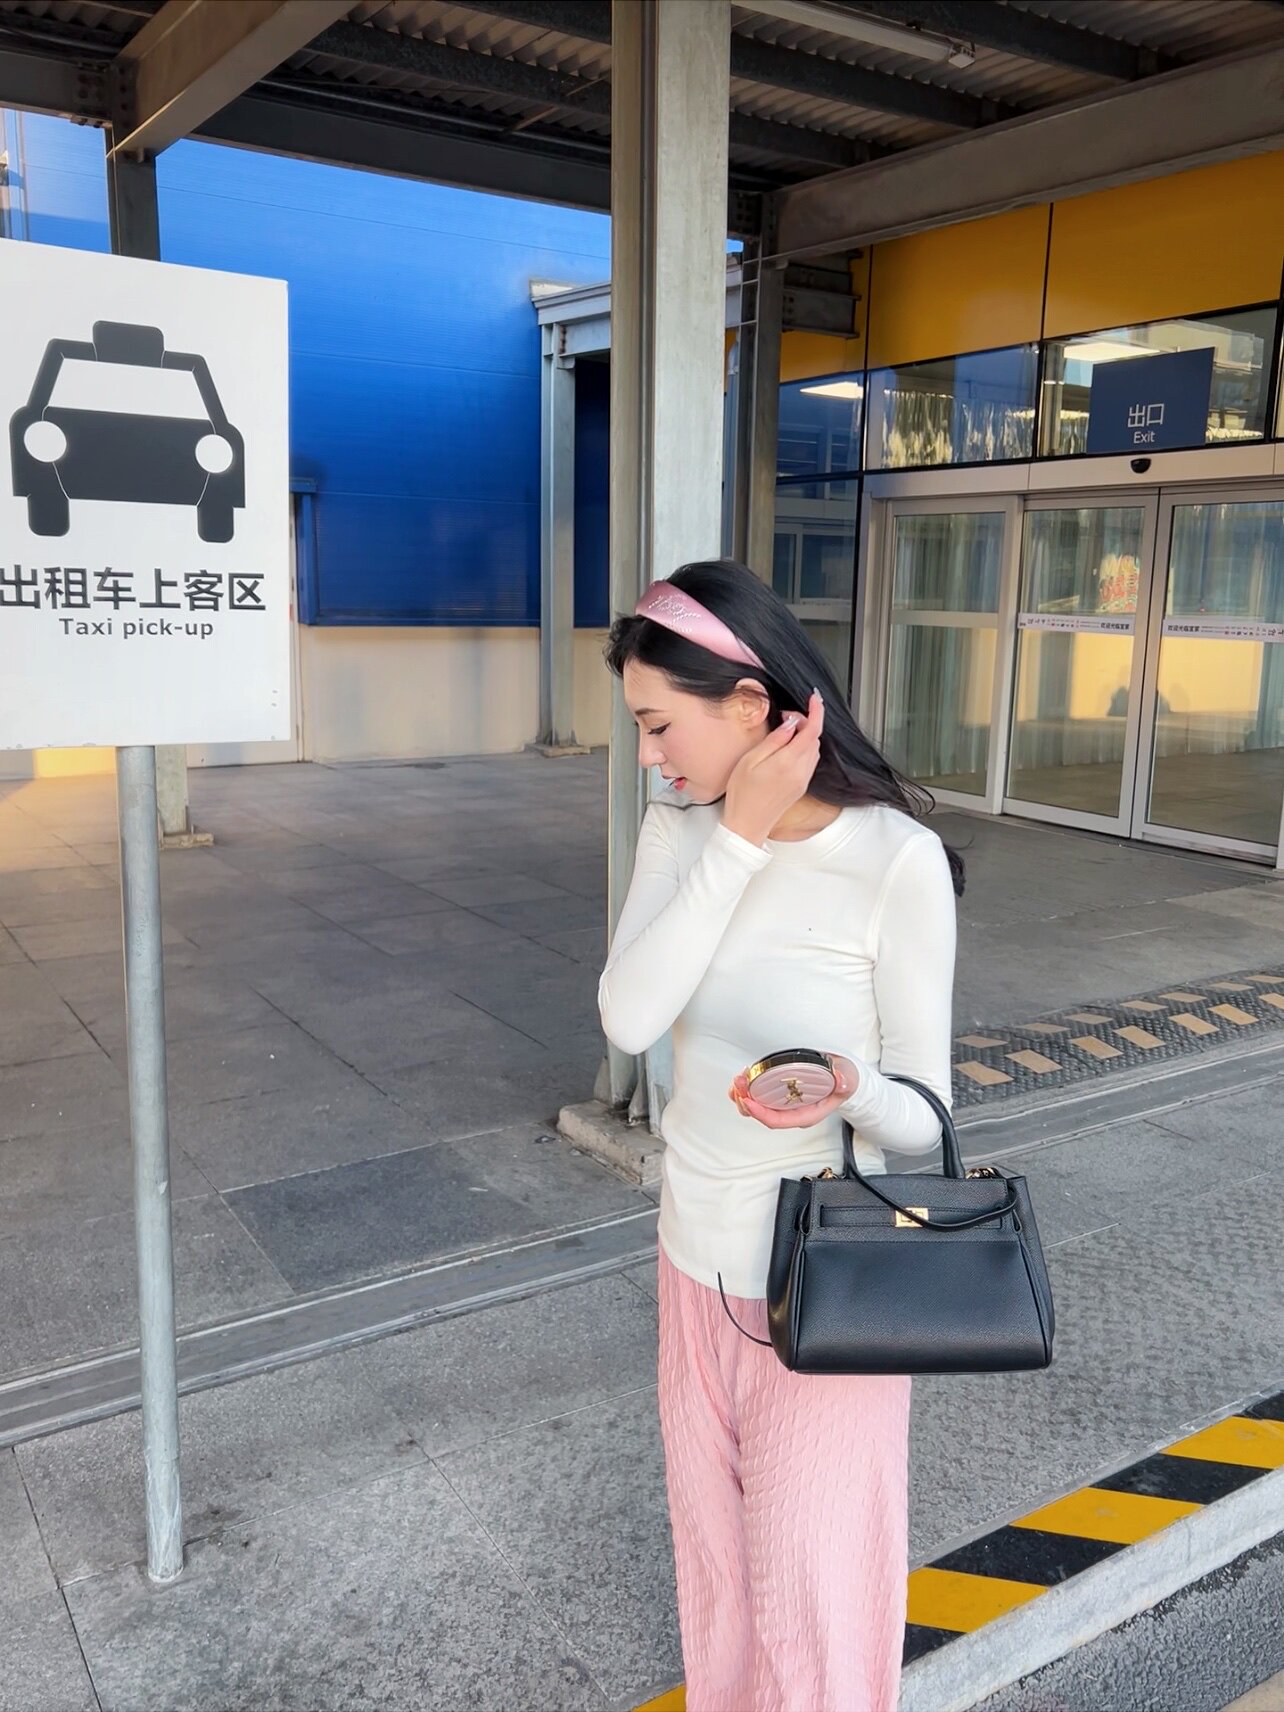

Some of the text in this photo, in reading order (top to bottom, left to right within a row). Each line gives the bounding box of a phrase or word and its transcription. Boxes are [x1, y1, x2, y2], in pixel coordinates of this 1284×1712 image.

[1128, 404, 1165, 427] 出口
[1134, 431, 1155, 443] Exit
[0, 564, 267, 611] 出租车上客区
[59, 618, 214, 639] Taxi pick-up
